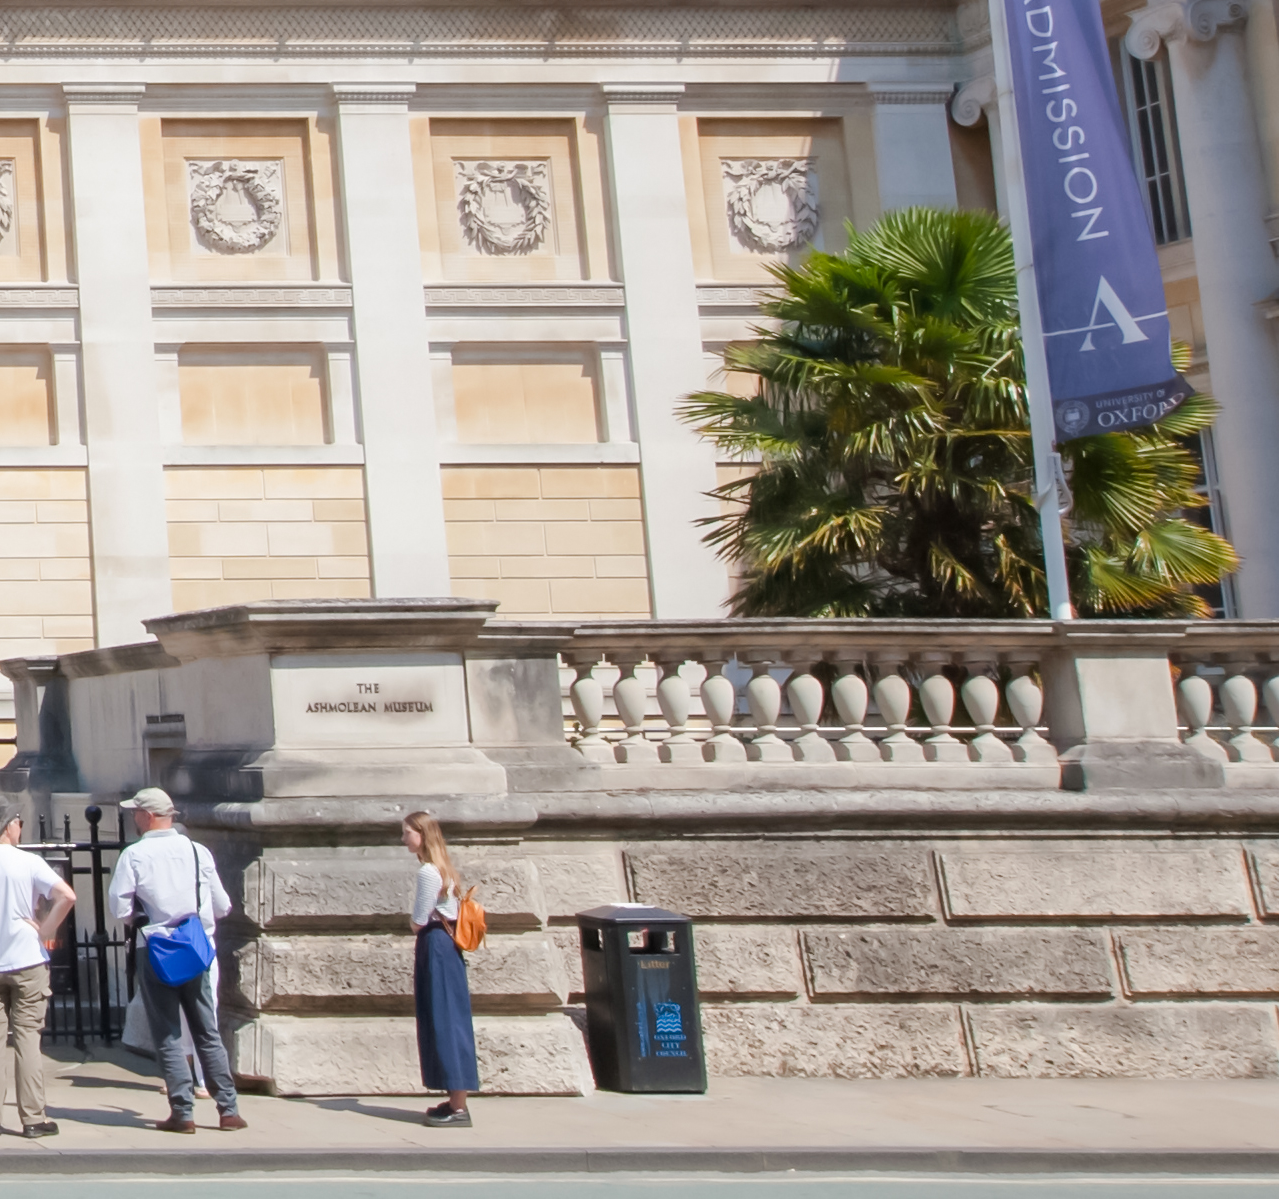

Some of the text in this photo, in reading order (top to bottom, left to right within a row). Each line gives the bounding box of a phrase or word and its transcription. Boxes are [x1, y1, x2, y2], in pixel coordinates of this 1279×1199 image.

[1079, 274, 1150, 352] A
[1095, 391, 1154, 409] UNIVERSITY
[356, 683, 380, 694] THE
[306, 701, 434, 713] ASHMOLEAN MUSEUM
[640, 960, 670, 969] Litter
